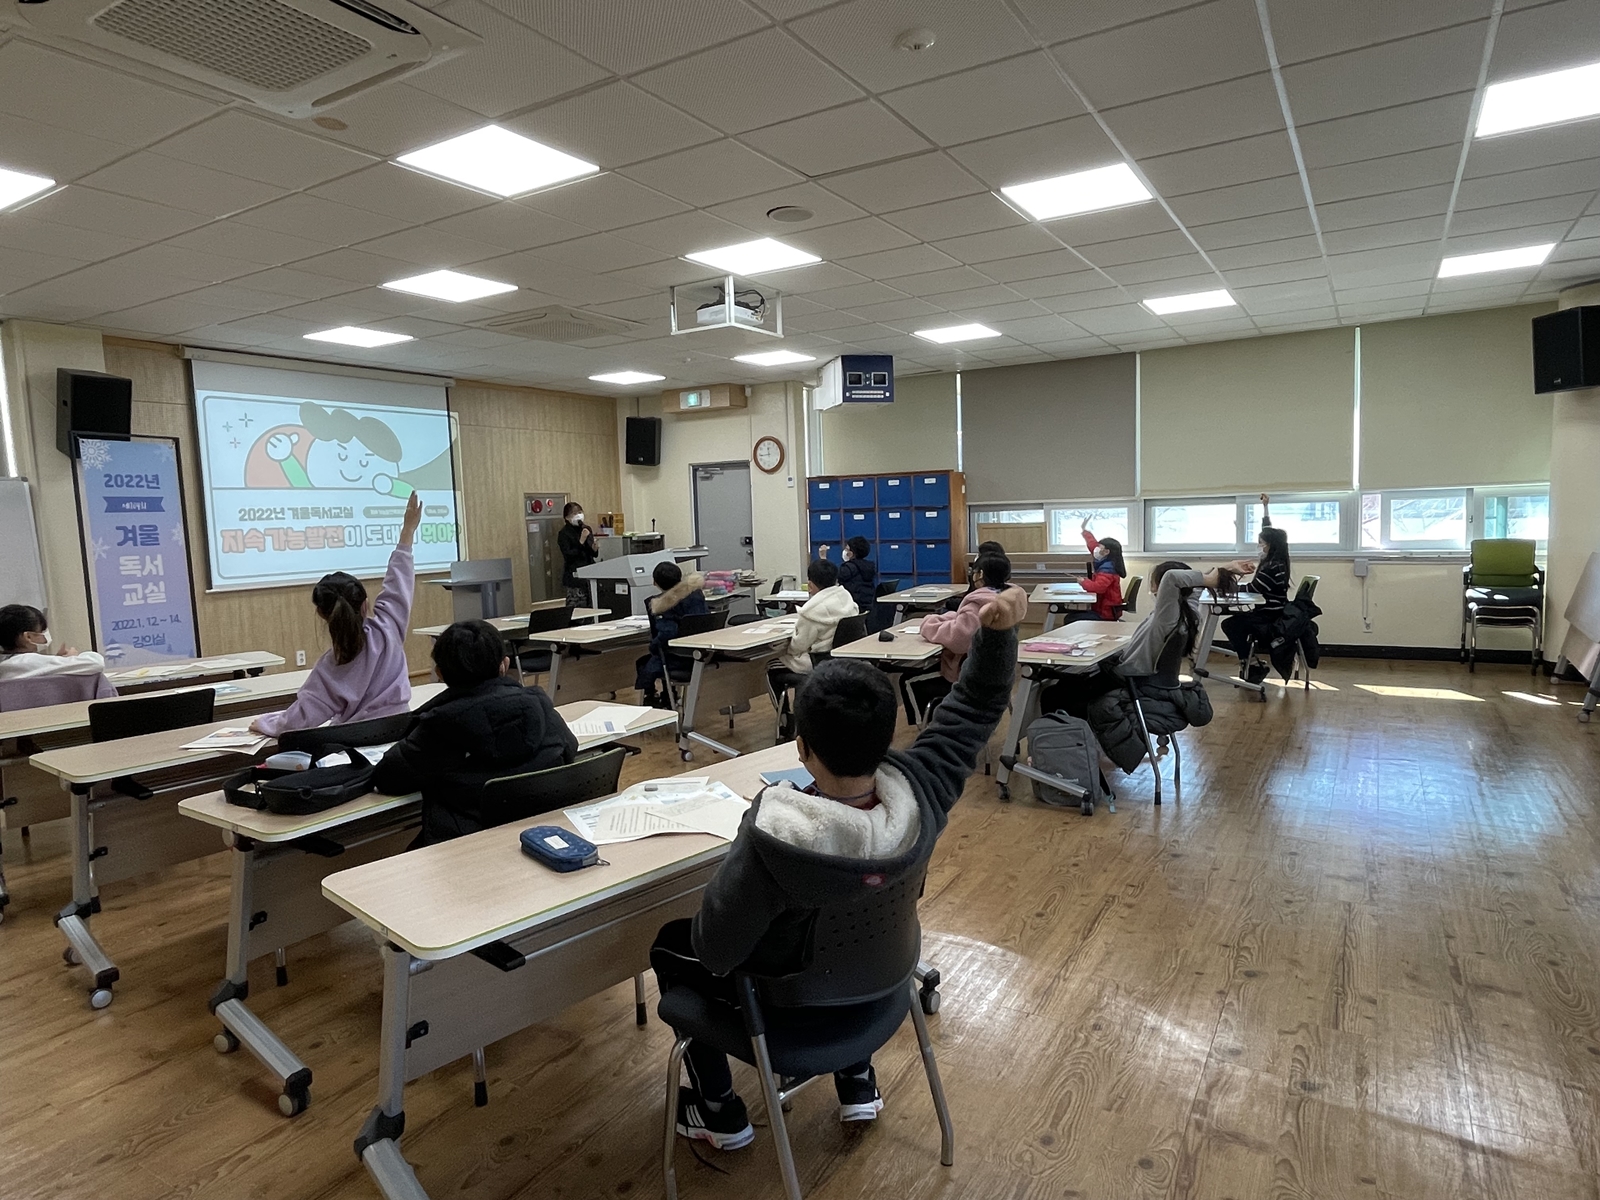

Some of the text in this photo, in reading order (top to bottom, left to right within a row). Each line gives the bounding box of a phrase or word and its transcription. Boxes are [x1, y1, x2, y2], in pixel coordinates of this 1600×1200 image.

[103, 473, 161, 489] 2022년
[238, 506, 286, 521] 2022년
[115, 524, 160, 547] 겨울
[364, 523, 418, 547] 도대
[119, 554, 164, 577] 독서
[121, 580, 167, 606] 교실
[132, 632, 166, 649] 강의실
